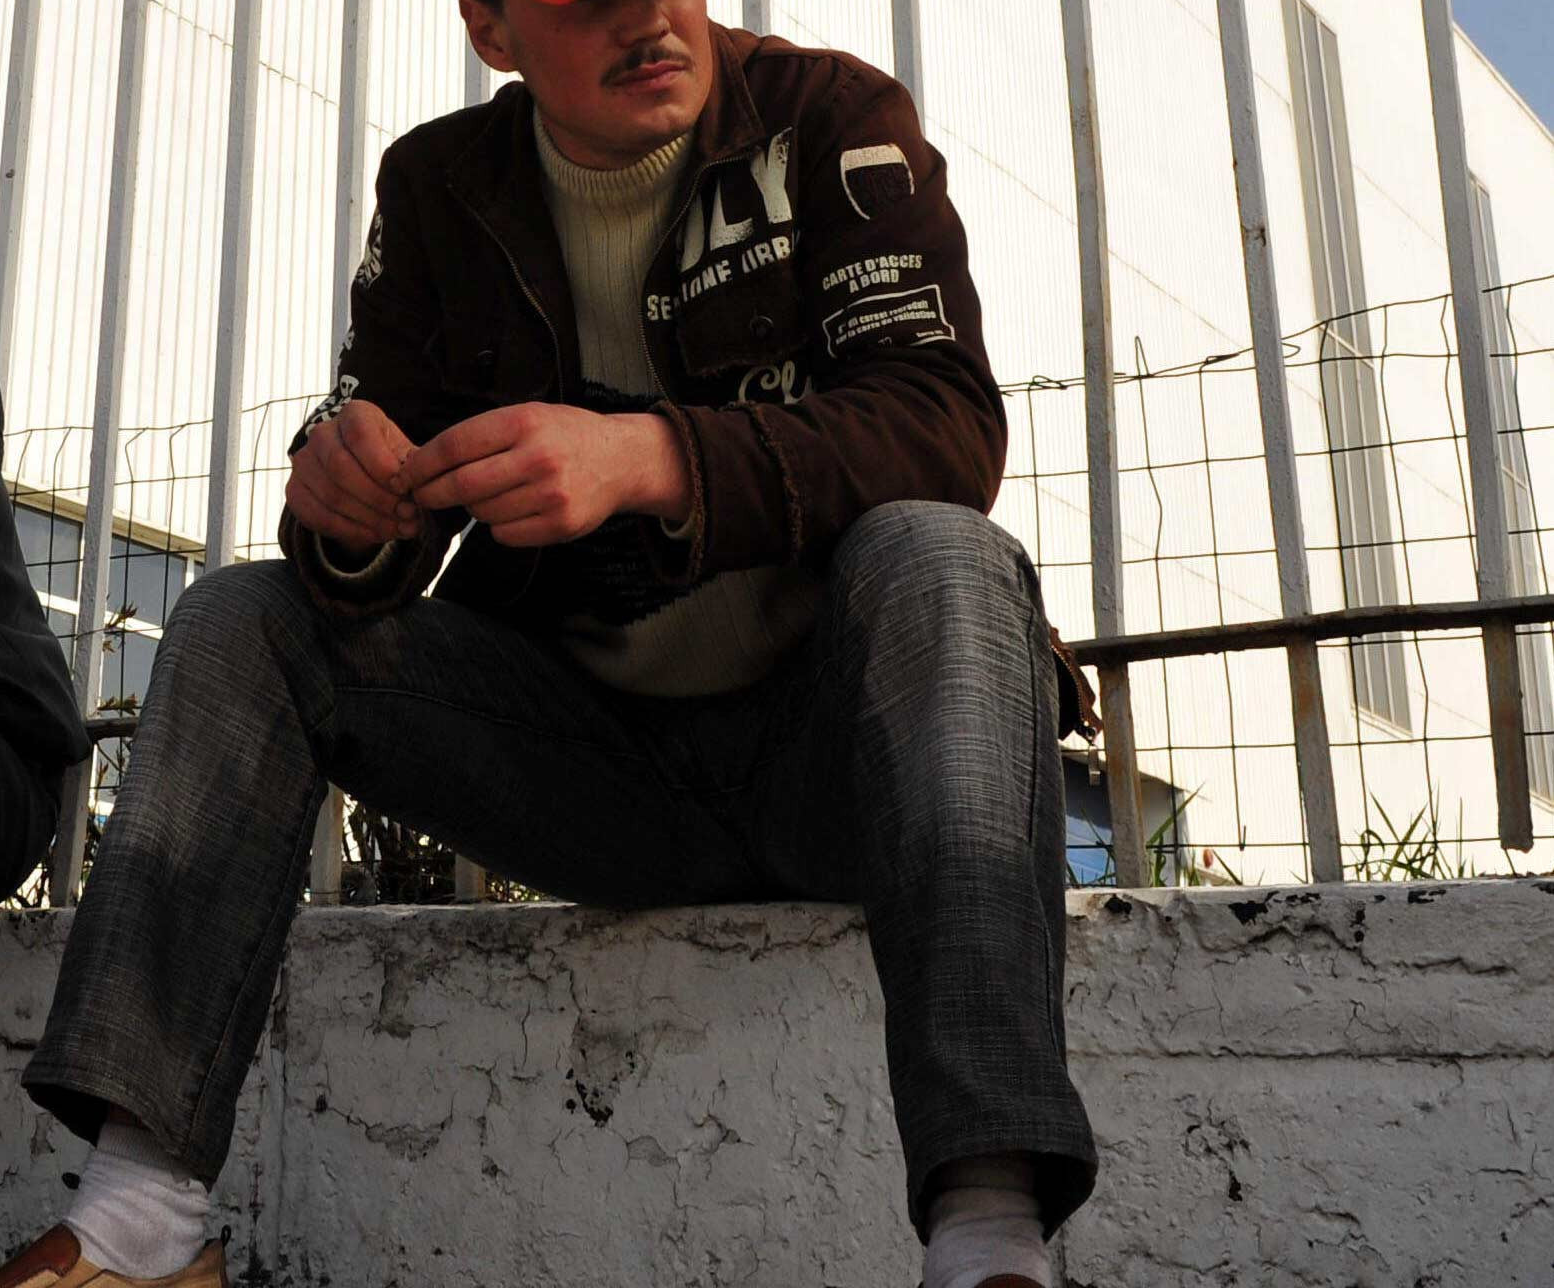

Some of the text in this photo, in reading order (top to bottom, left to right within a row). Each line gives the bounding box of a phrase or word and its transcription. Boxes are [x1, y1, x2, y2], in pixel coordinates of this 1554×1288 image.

[822, 254, 923, 291] CARTE D'ACCES
[849, 269, 900, 294] A BORD
